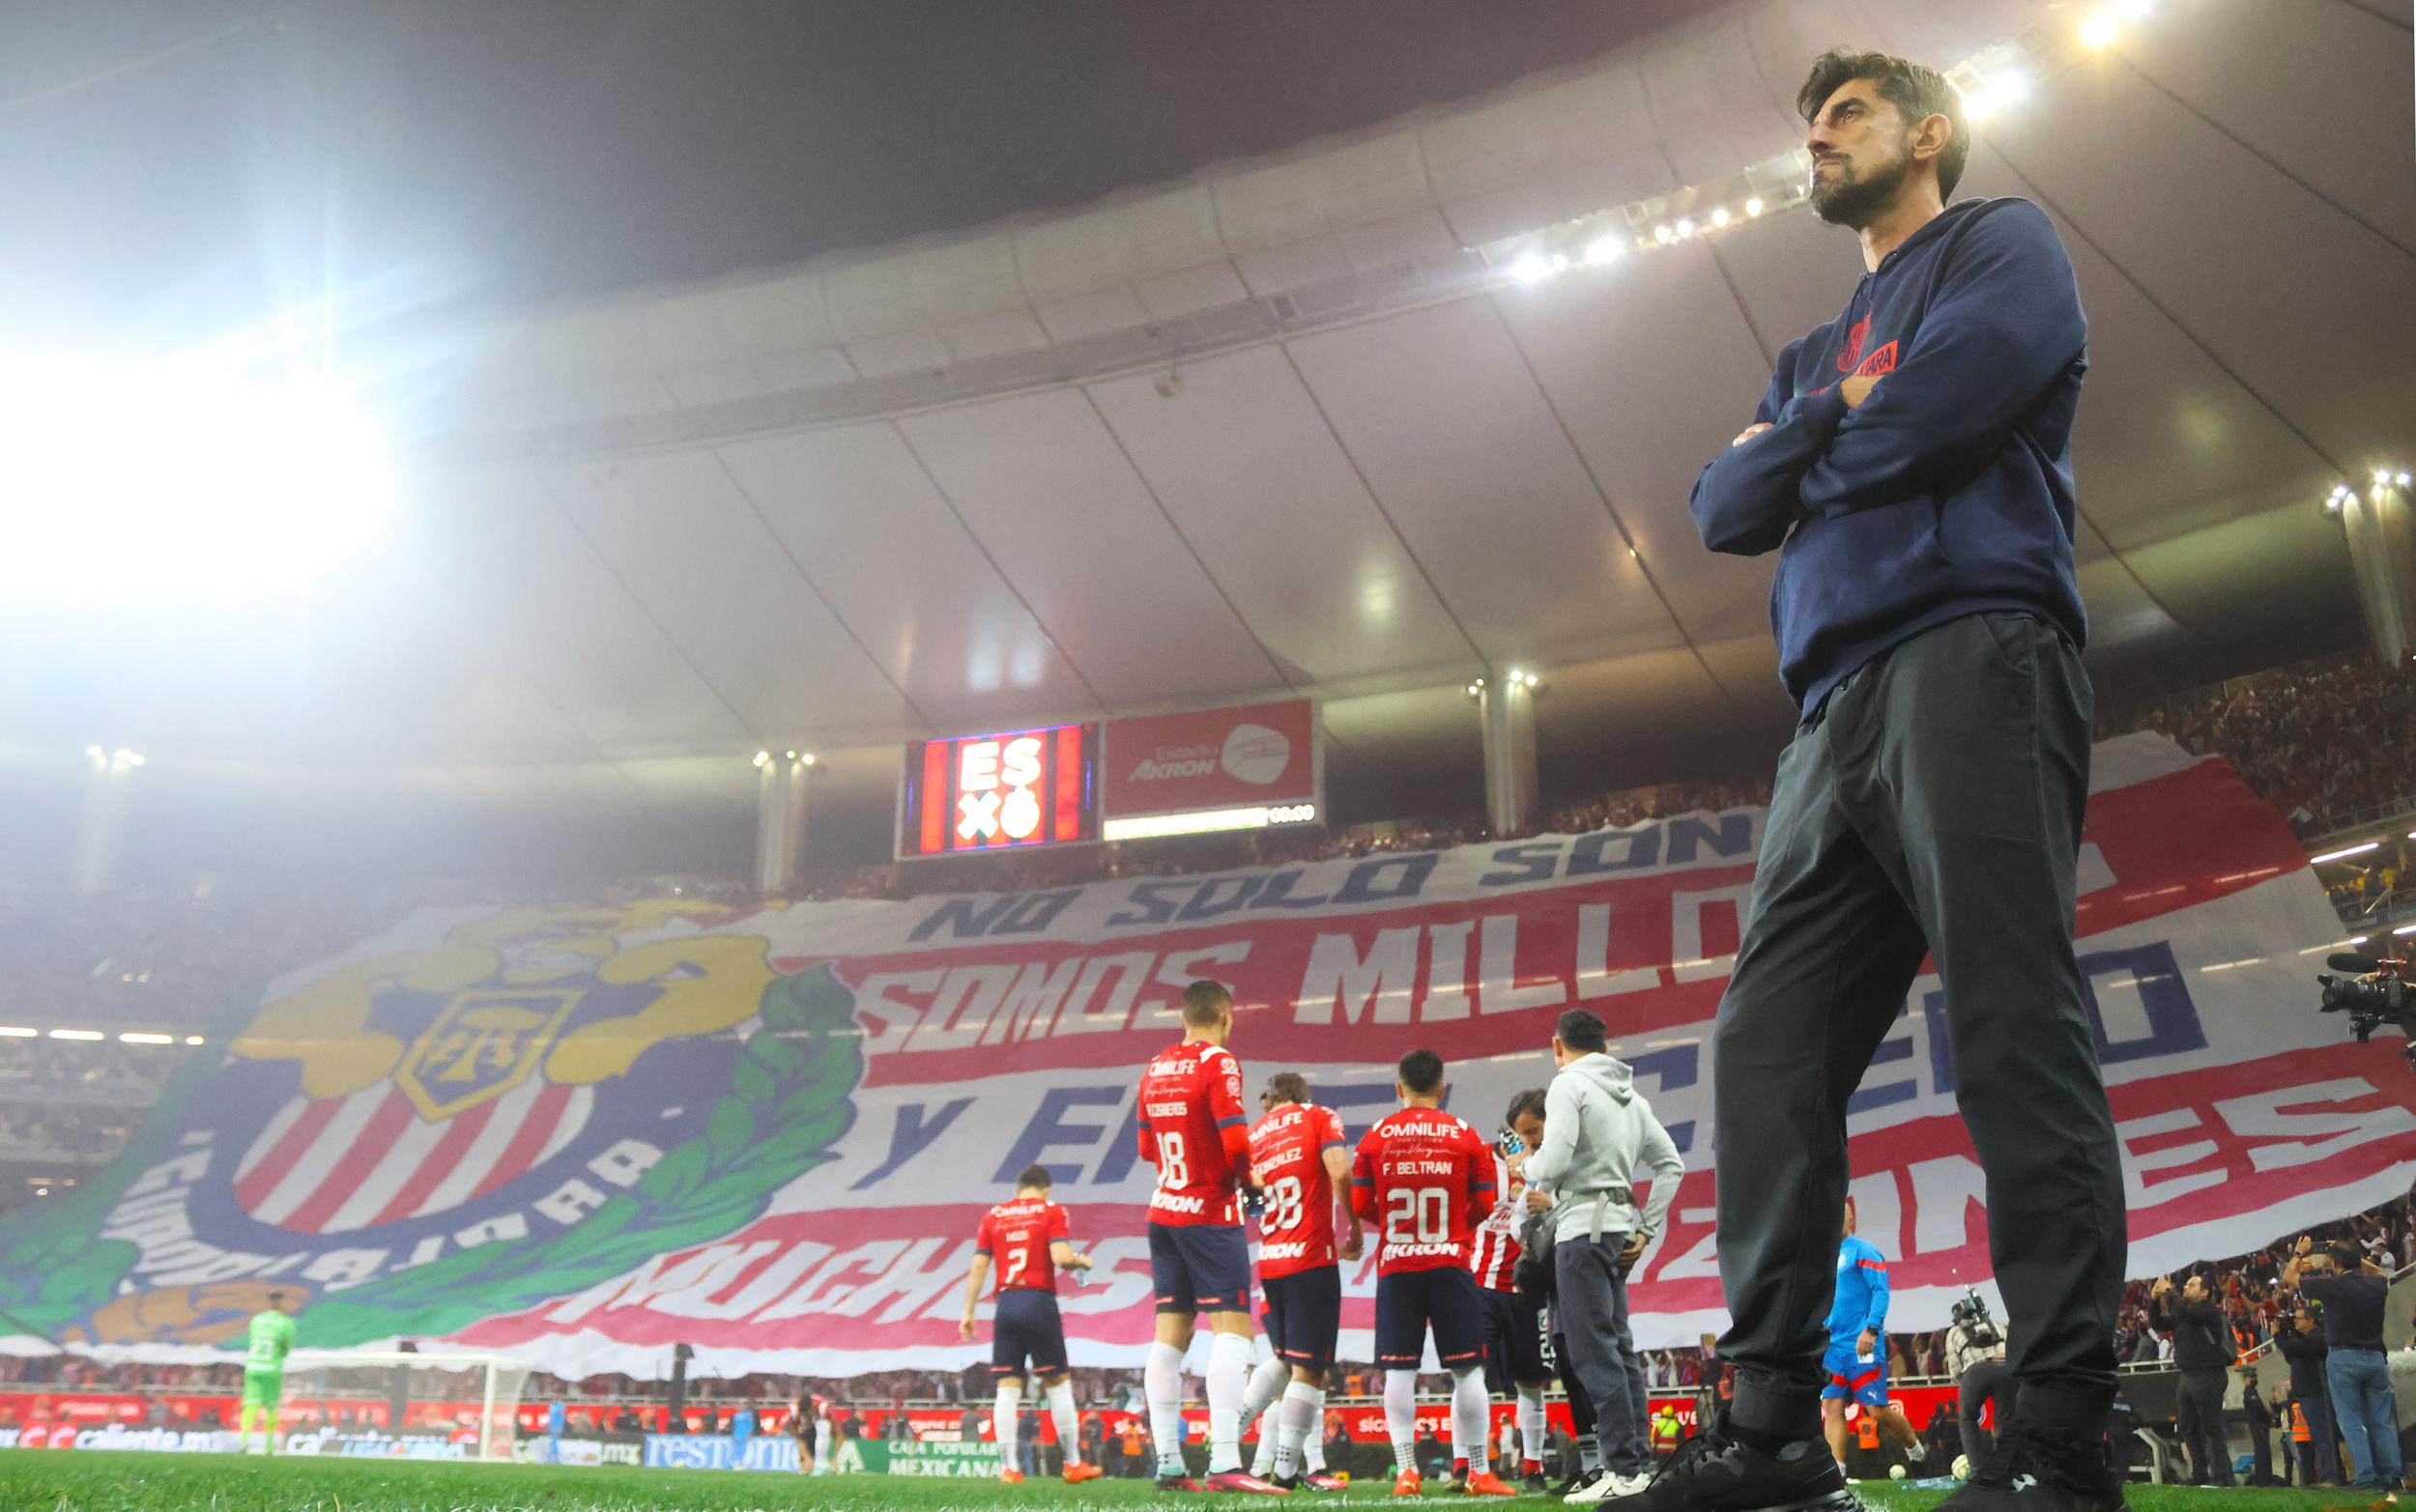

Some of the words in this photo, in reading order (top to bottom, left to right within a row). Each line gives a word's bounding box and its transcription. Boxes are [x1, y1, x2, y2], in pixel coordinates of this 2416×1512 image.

[961, 737, 1042, 791] ES
[907, 888, 1083, 942] NO
[1104, 851, 1439, 927] SOLO
[1479, 813, 1753, 887] SON
[853, 940, 1253, 1055] SOMOS
[1294, 882, 1755, 1024] MILLO
[1380, 1123, 1459, 1139] OMNILIFE
[1396, 1161, 1452, 1176] BELTRAN
[1386, 1187, 1449, 1243] 20
[544, 1236, 1156, 1326] MUCHS
[1380, 1242, 1459, 1267] AKRON
[887, 1459, 1001, 1477] MEXICANA
